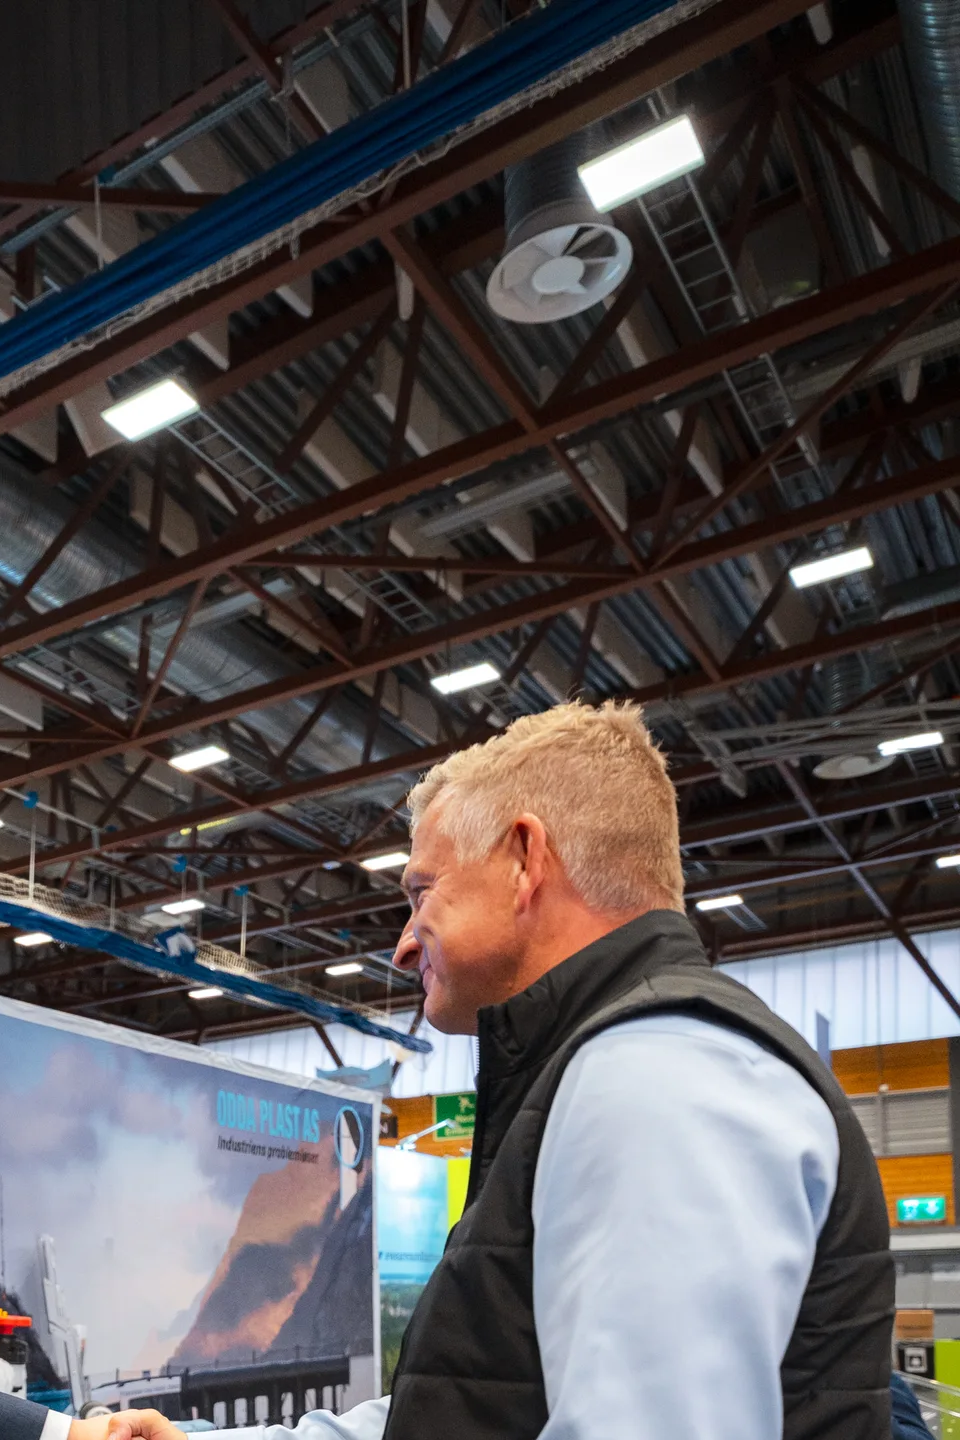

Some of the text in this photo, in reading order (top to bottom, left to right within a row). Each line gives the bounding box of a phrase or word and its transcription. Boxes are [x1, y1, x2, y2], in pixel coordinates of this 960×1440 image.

[217, 1089, 320, 1144] ODDA PLAST AS
